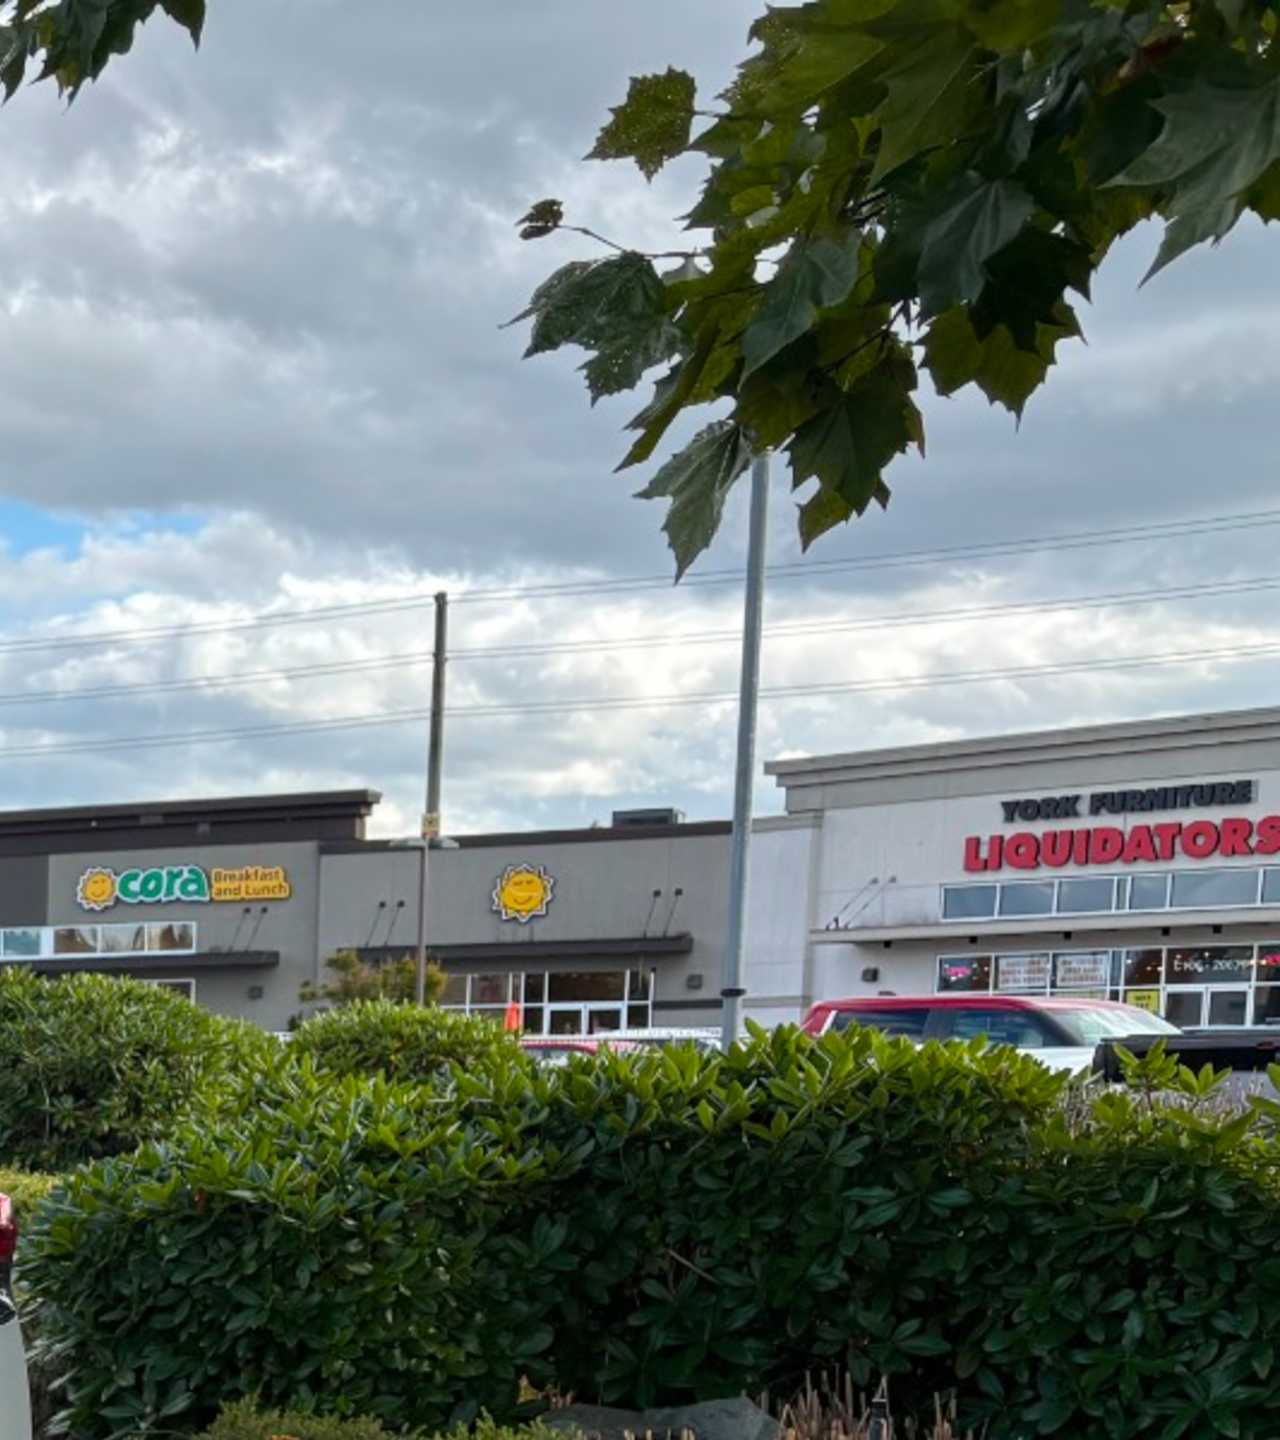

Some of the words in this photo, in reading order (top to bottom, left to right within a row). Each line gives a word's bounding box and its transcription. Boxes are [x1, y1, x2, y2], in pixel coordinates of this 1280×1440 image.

[1001, 795, 1081, 823] YORK
[1089, 779, 1254, 816] FURNITURE
[964, 815, 1280, 872] LIQUIDATORS
[117, 866, 208, 901] cora
[213, 867, 281, 882] Breakfast
[214, 883, 241, 896] and
[244, 883, 287, 896] Lunch
